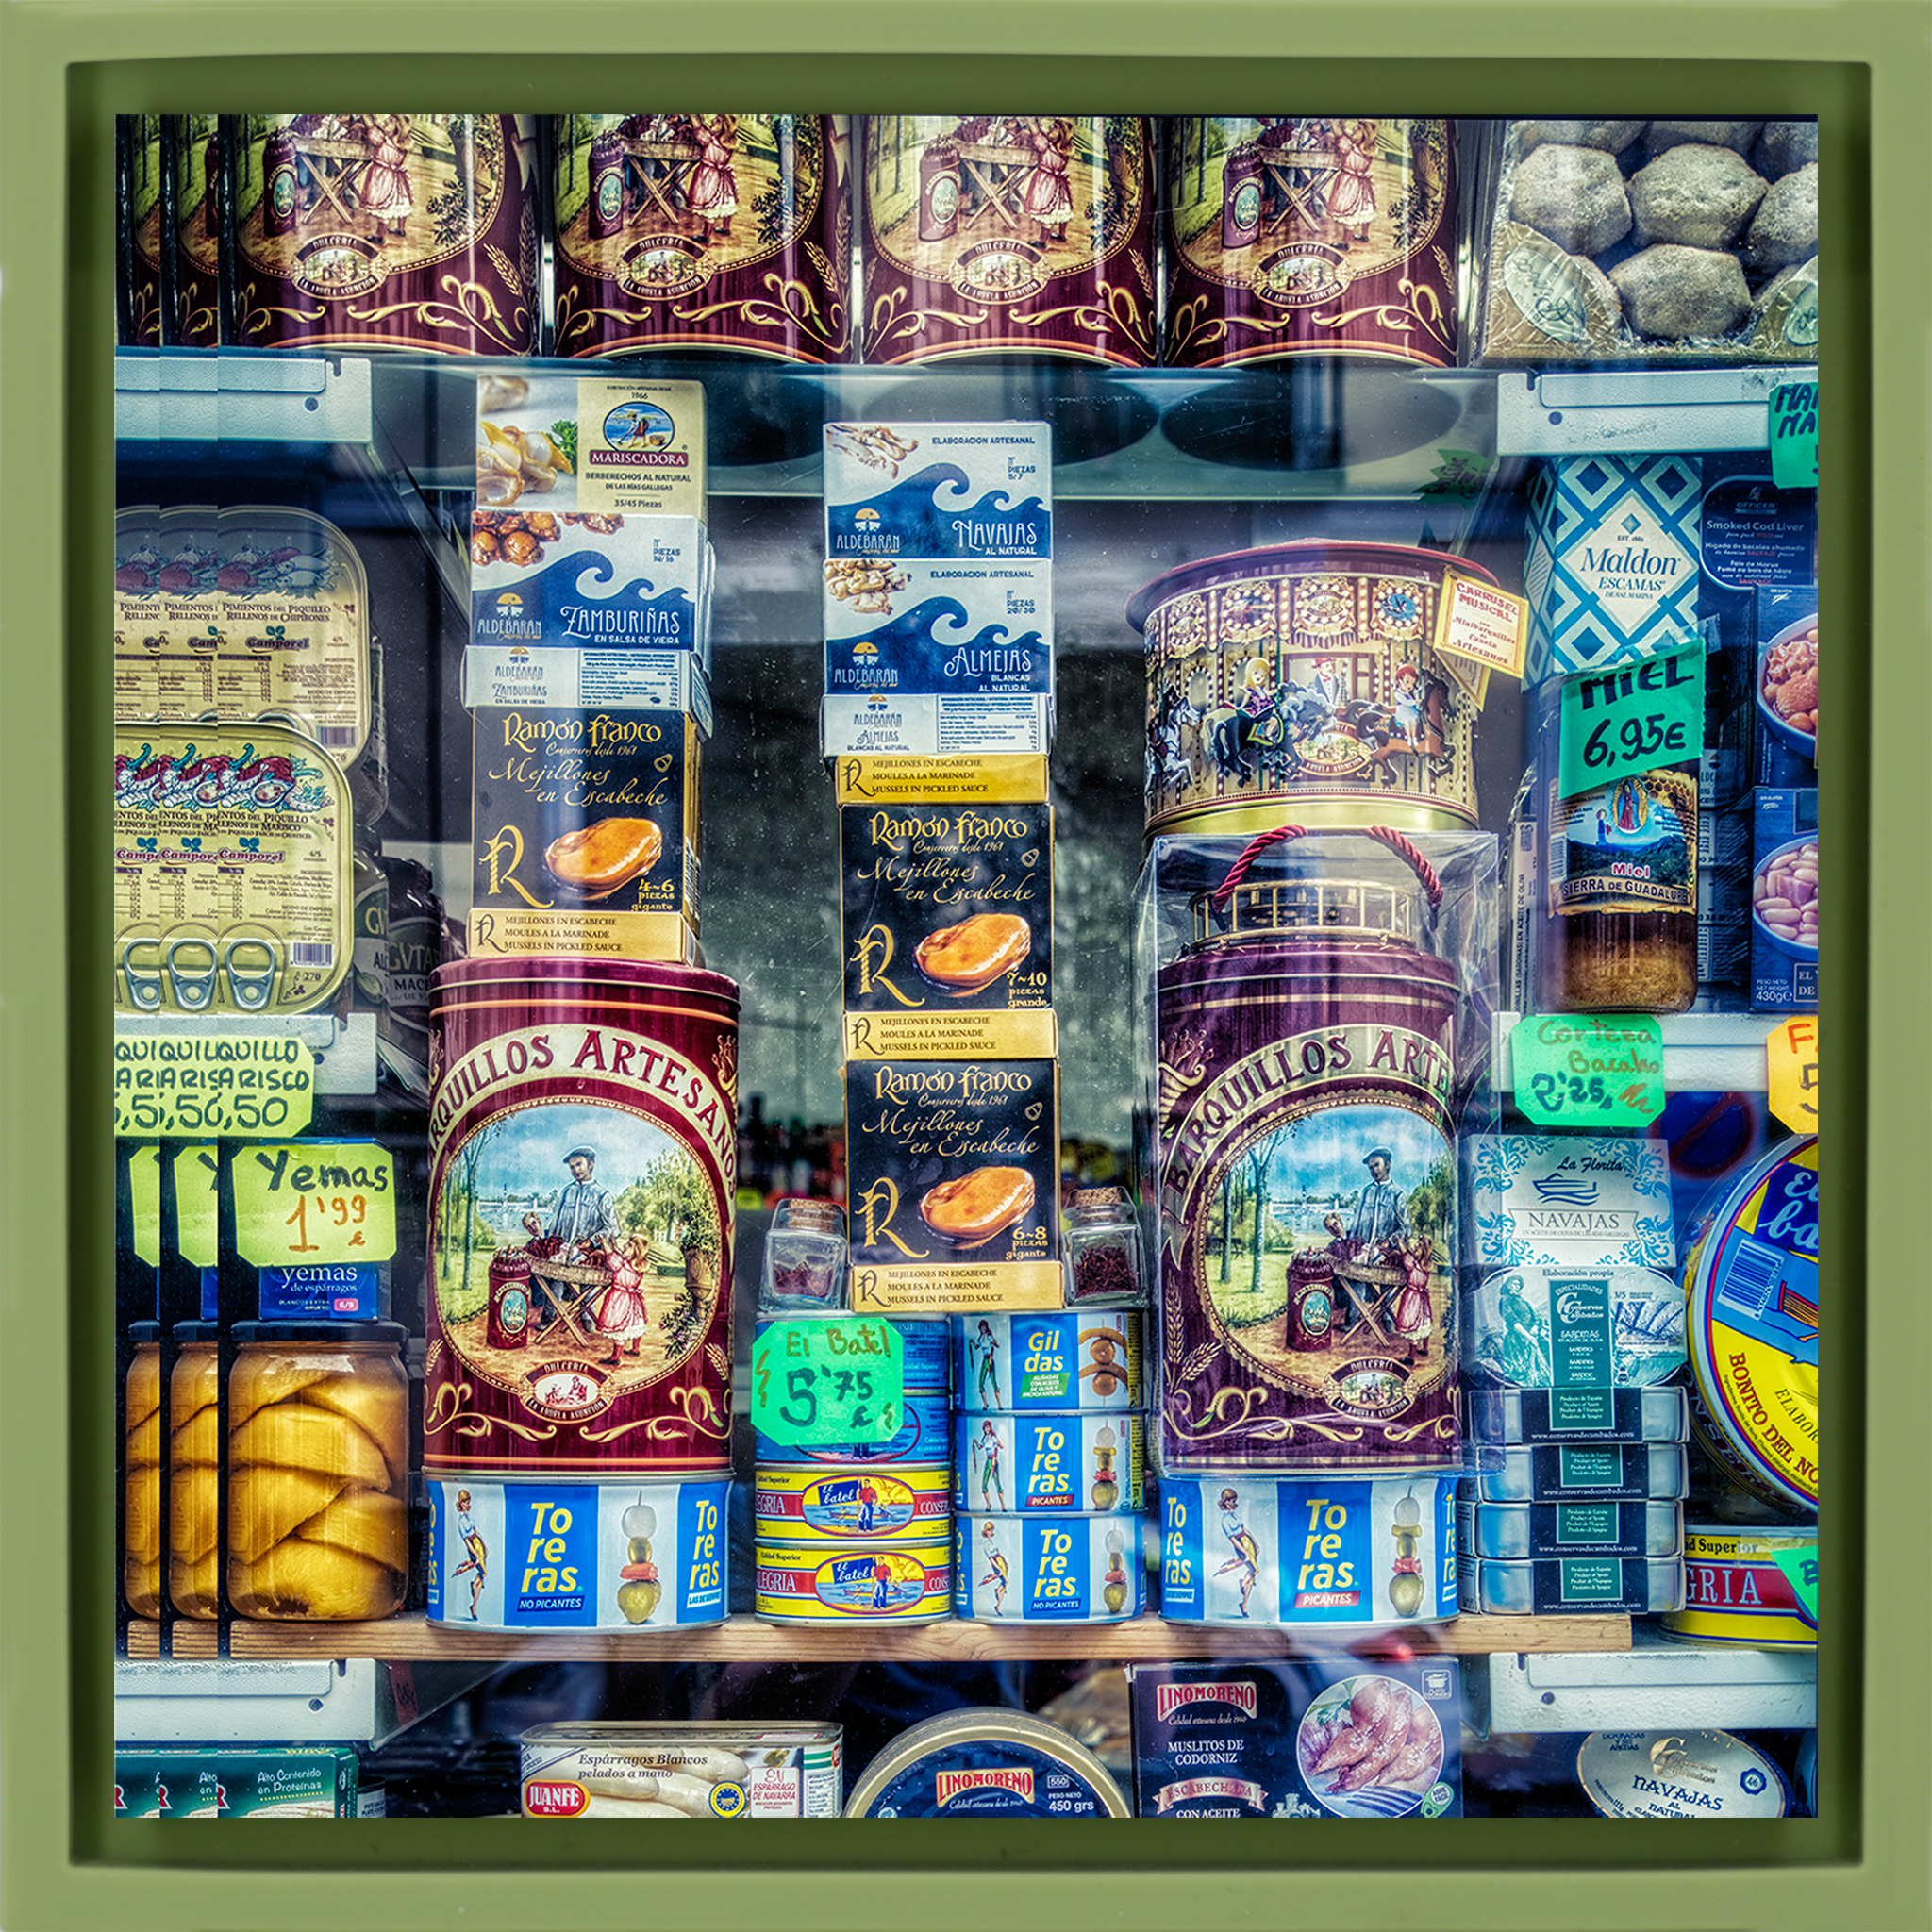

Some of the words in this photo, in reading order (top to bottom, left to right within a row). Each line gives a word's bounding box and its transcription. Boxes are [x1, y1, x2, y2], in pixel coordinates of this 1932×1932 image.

[591, 452, 685, 465] MARISCADORA
[586, 473, 642, 481] BERBERECHOS
[655, 474, 691, 482] NATURAL
[614, 499, 636, 508] 35/45
[638, 499, 662, 508] Piezas
[1707, 521, 1750, 530] Smoked
[1752, 522, 1774, 531] Cod
[1776, 523, 1804, 531] Liver
[952, 520, 1036, 551] NAVAJAS
[1580, 547, 1677, 575] Maldon
[1599, 577, 1661, 591] ESCAMAS
[1457, 582, 1518, 615] CARRUSEL
[223, 603, 271, 612] PIMIENTOS
[288, 604, 330, 613] PIQUILLO
[226, 612, 267, 621] RELLENOS
[1459, 594, 1512, 622] MUSICAL
[561, 606, 680, 639] ZAMBURIÑAS
[608, 635, 635, 643] SALSA
[652, 636, 679, 644] VIEIRA
[1453, 640, 1508, 664] Artesanos
[944, 647, 1031, 677] ALMEJAS
[991, 674, 1030, 682] BLANCAS
[503, 712, 582, 753] Ramón
[489, 758, 610, 793] Mejillones
[537, 791, 559, 802] en
[564, 777, 668, 807] Escabeche
[872, 785, 909, 793] MUSSELS
[261, 823, 300, 831] MARISCO
[264, 814, 308, 824] PIQUILLO
[869, 811, 949, 851] Ramón
[219, 849, 282, 862] Camporel
[857, 856, 978, 891] Mejillones
[1612, 862, 1650, 877] Miel
[906, 889, 927, 900] en
[933, 873, 1035, 904] Escabeche
[1562, 879, 1604, 895] SIERRA
[1608, 881, 1623, 890] DE
[631, 903, 673, 911] gigante
[304, 972, 320, 980] 270
[1008, 998, 1047, 1009] grande
[570, 1028, 738, 1200] ARTESANOS
[1167, 1035, 1353, 1194] BARQUILLOS
[255, 1150, 388, 1191] Yemas
[1557, 1156, 1578, 1171] La
[1581, 1157, 1623, 1174] Florita
[1528, 1212, 1620, 1231] NAVAJAS
[283, 1265, 357, 1288] yemas
[1542, 1269, 1588, 1277] Elaboración
[291, 1283, 302, 1291] de
[304, 1283, 357, 1294] espárragos
[827, 1324, 891, 1357] Batel
[1029, 1330, 1059, 1351] Gil
[1024, 1354, 1063, 1373] das
[528, 1398, 539, 1407] LA
[1728, 1352, 1767, 1426] BONITO
[1761, 1424, 1795, 1466] DEL
[1034, 1427, 1064, 1450] To
[1032, 1453, 1060, 1471] re
[1028, 1474, 1069, 1492] ras
[824, 1488, 855, 1503] batel
[1031, 1496, 1068, 1506] PICANTES
[531, 1502, 572, 1535] To
[1306, 1499, 1347, 1531] To
[527, 1537, 565, 1564] re
[1041, 1529, 1072, 1554] To
[1303, 1534, 1341, 1559] re
[1699, 1538, 1758, 1555] Superior
[1039, 1555, 1067, 1574] re
[521, 1568, 578, 1592] ras
[838, 1568, 870, 1580] batel
[1297, 1562, 1354, 1590] ras
[1034, 1577, 1076, 1597] ras
[1046, 1601, 1079, 1609] PICANTES
[1168, 1740, 1224, 1753] MUSLITOS
[1227, 1740, 1244, 1750] DE
[578, 1754, 654, 1765] Espárragos
[658, 1754, 708, 1765] Blancos
[1175, 1754, 1237, 1765] CODORNIZ
[258, 1772, 275, 1782] Alto
[276, 1768, 322, 1781] Contenido
[578, 1769, 625, 1780] pelados
[274, 1782, 322, 1793] Proteínas
[530, 1786, 580, 1806] JUANFE
[753, 1791, 762, 1800] DE
[763, 1791, 796, 1801] NAVARRA
[1049, 1800, 1071, 1811] 450
[1074, 1801, 1093, 1813] grs
[1206, 1808, 1240, 1818] ACEITE
